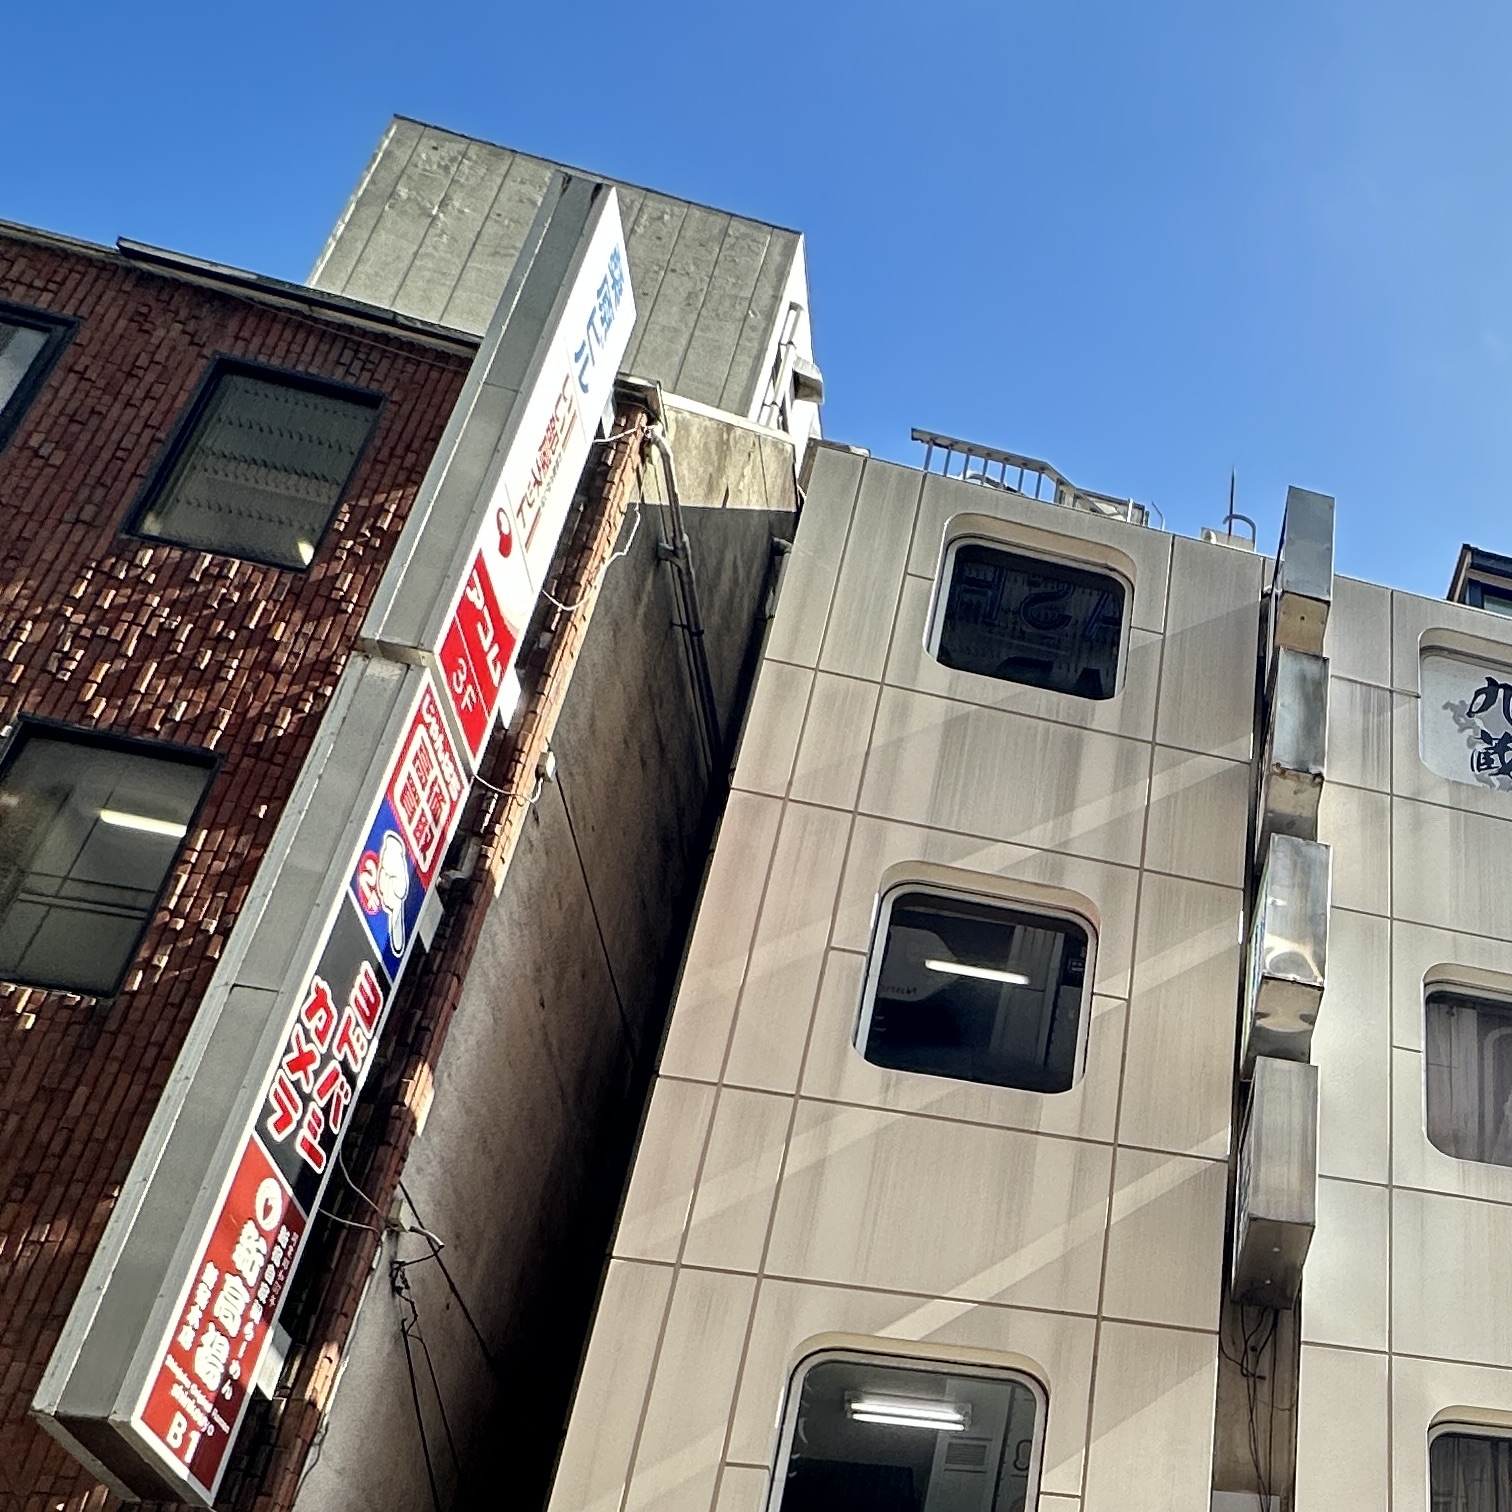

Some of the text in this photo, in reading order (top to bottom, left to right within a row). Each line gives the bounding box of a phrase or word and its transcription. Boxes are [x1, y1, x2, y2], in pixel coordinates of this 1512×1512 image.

[464, 569, 503, 689] アコム
[451, 656, 478, 712] 3F
